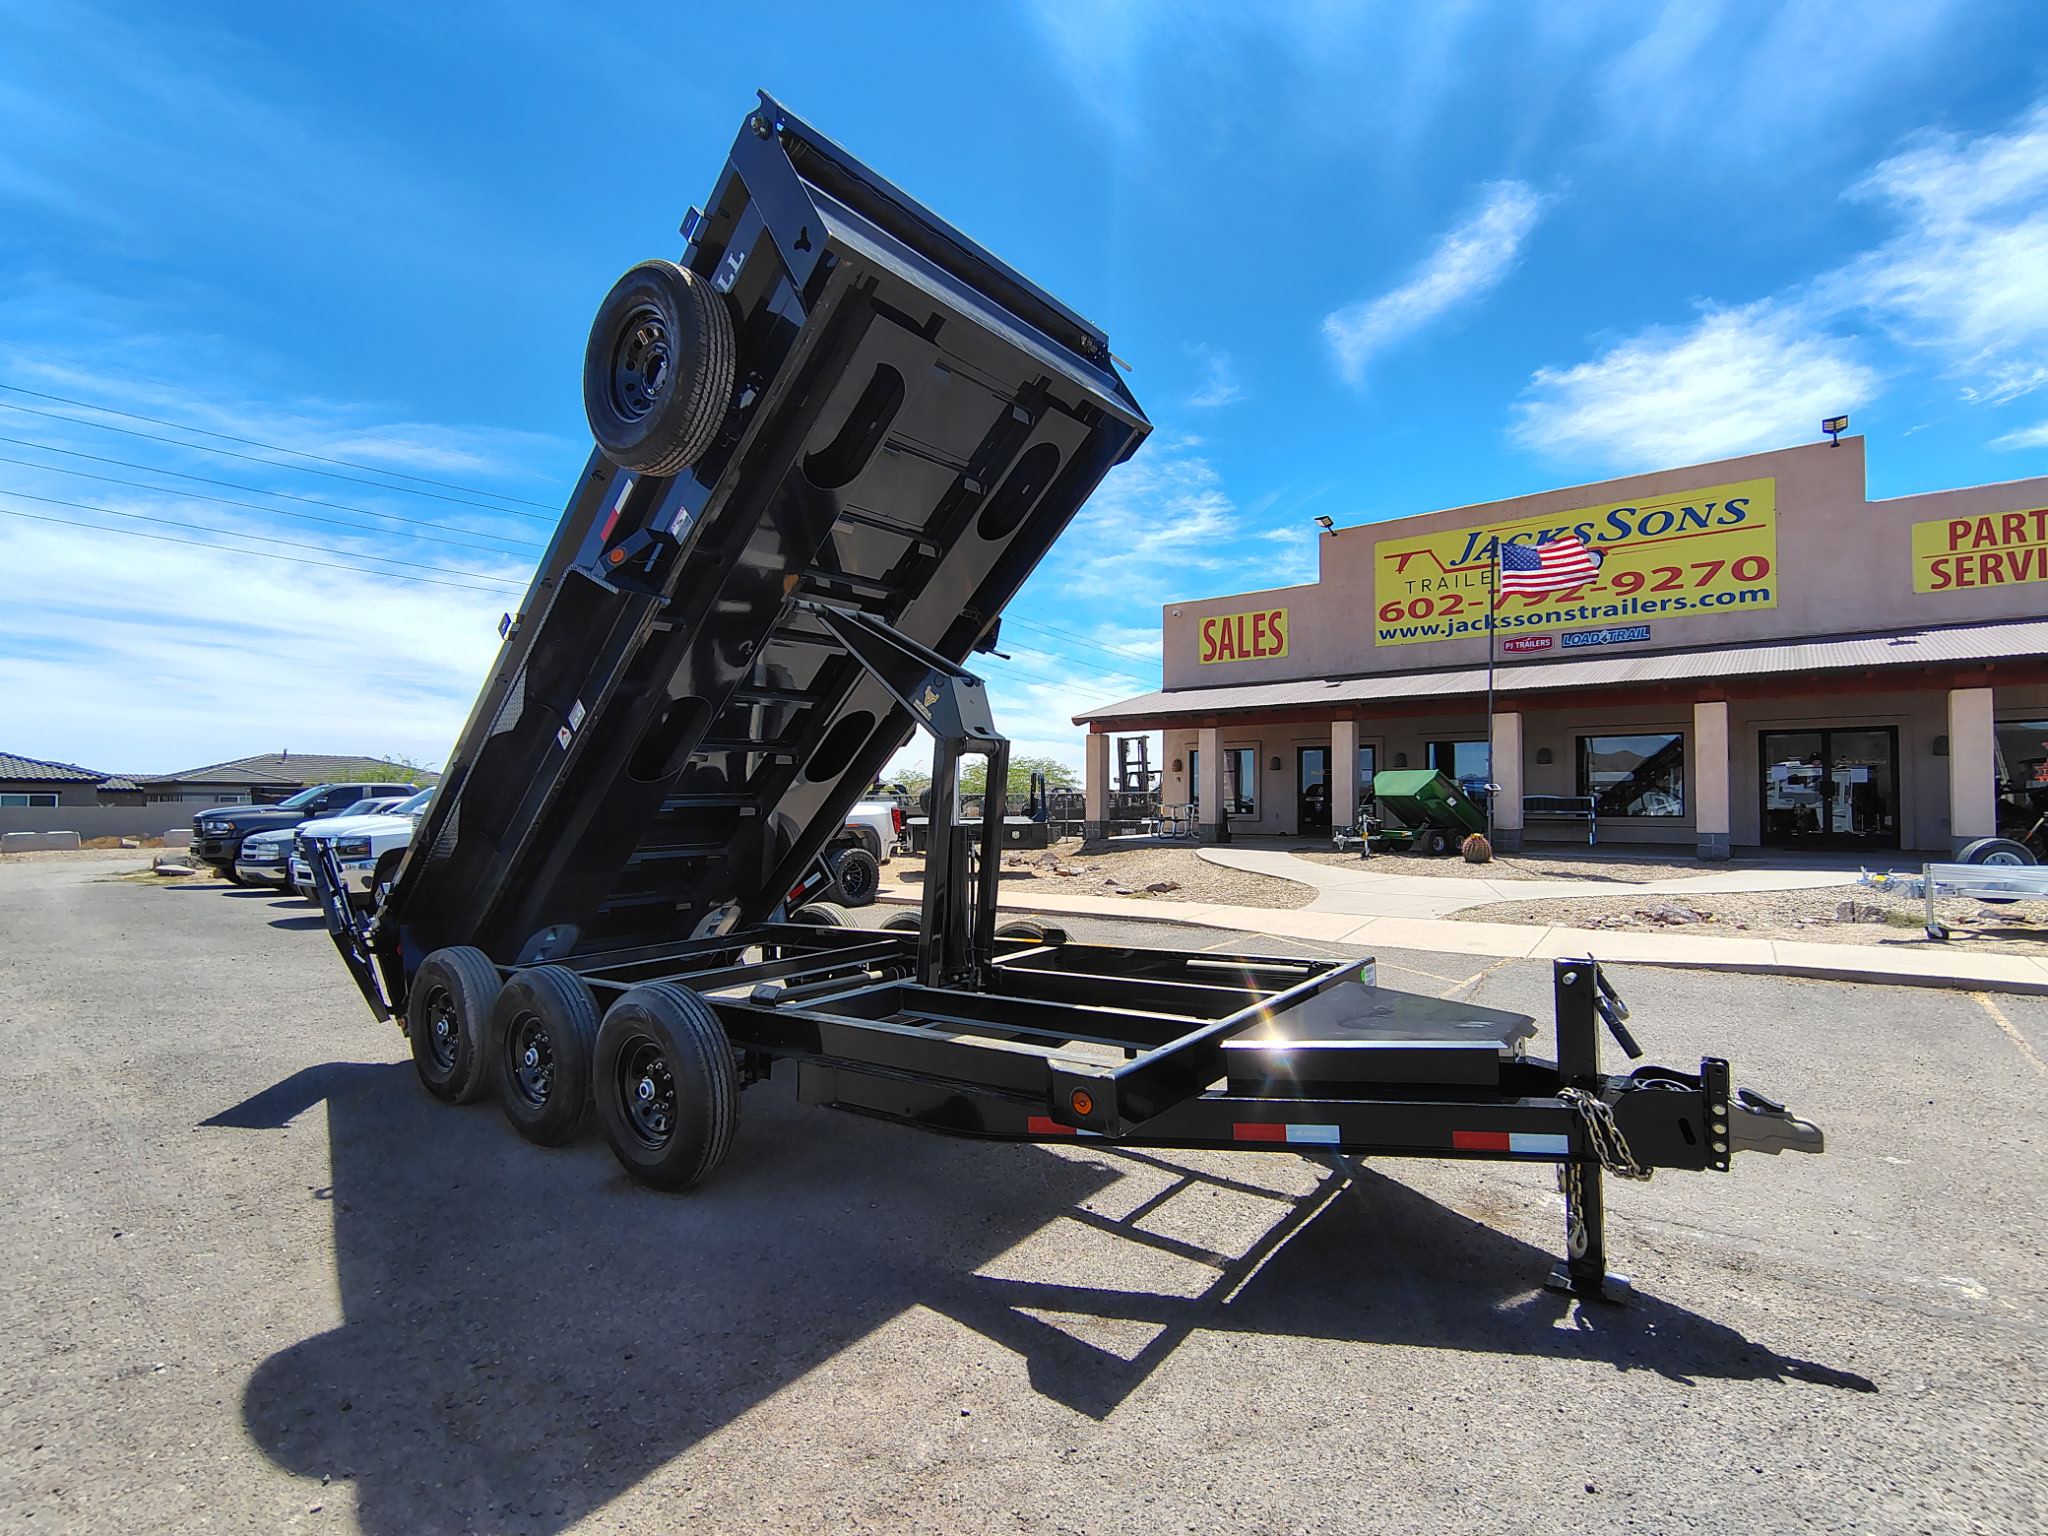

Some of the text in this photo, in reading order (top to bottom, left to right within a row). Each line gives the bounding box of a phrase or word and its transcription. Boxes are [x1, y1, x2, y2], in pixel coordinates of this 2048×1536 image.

[1405, 569, 1502, 595] TRAILE
[1378, 588, 1770, 640] www.jackssonstrailers.com
[1202, 611, 1284, 661] SALES
[1504, 638, 1551, 650] PJ TRAILERS
[1562, 626, 1650, 647] LOAD TRAIL
